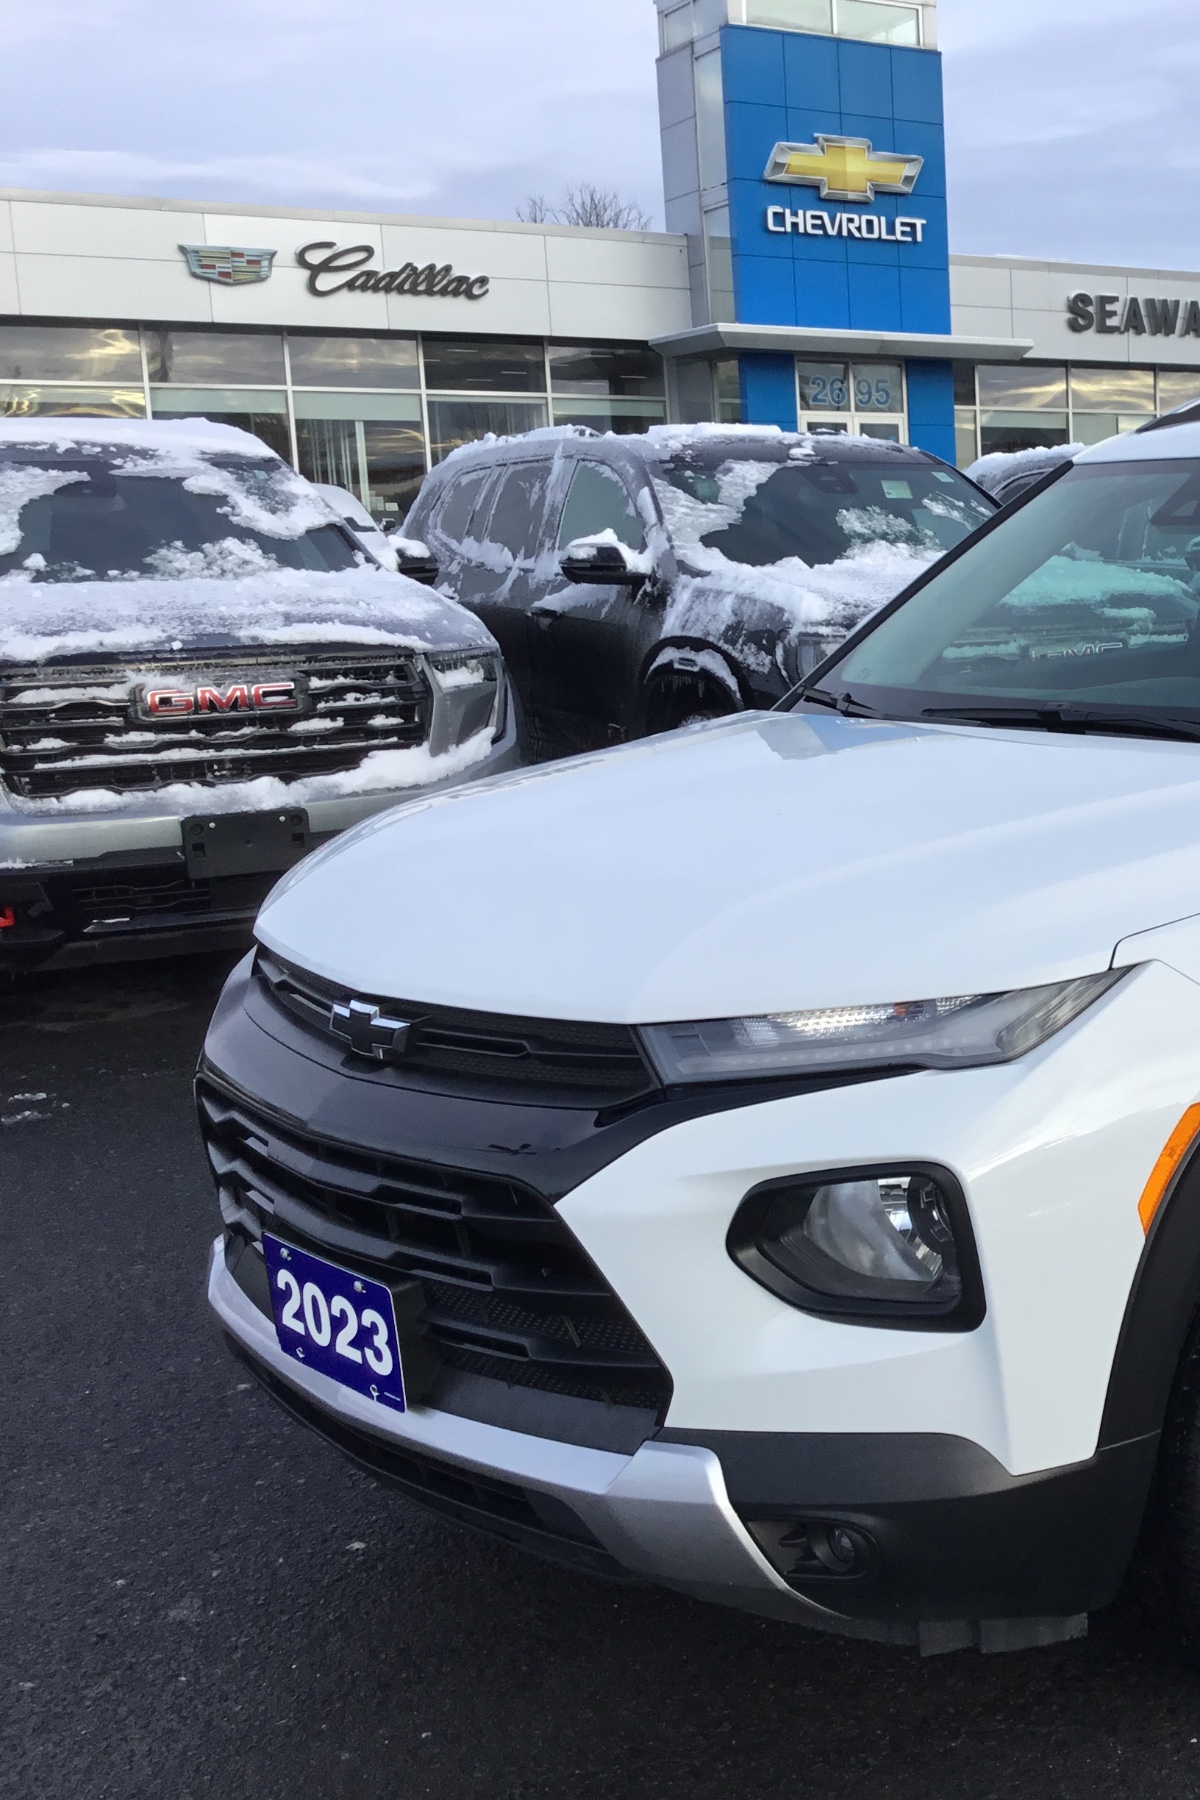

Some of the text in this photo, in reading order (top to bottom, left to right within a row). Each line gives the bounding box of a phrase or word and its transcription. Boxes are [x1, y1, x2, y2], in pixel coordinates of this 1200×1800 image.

[766, 205, 927, 242] CHEVROLET
[296, 241, 490, 300] Cadillac
[147, 682, 297, 715] GMC
[277, 1269, 393, 1376] 2023
